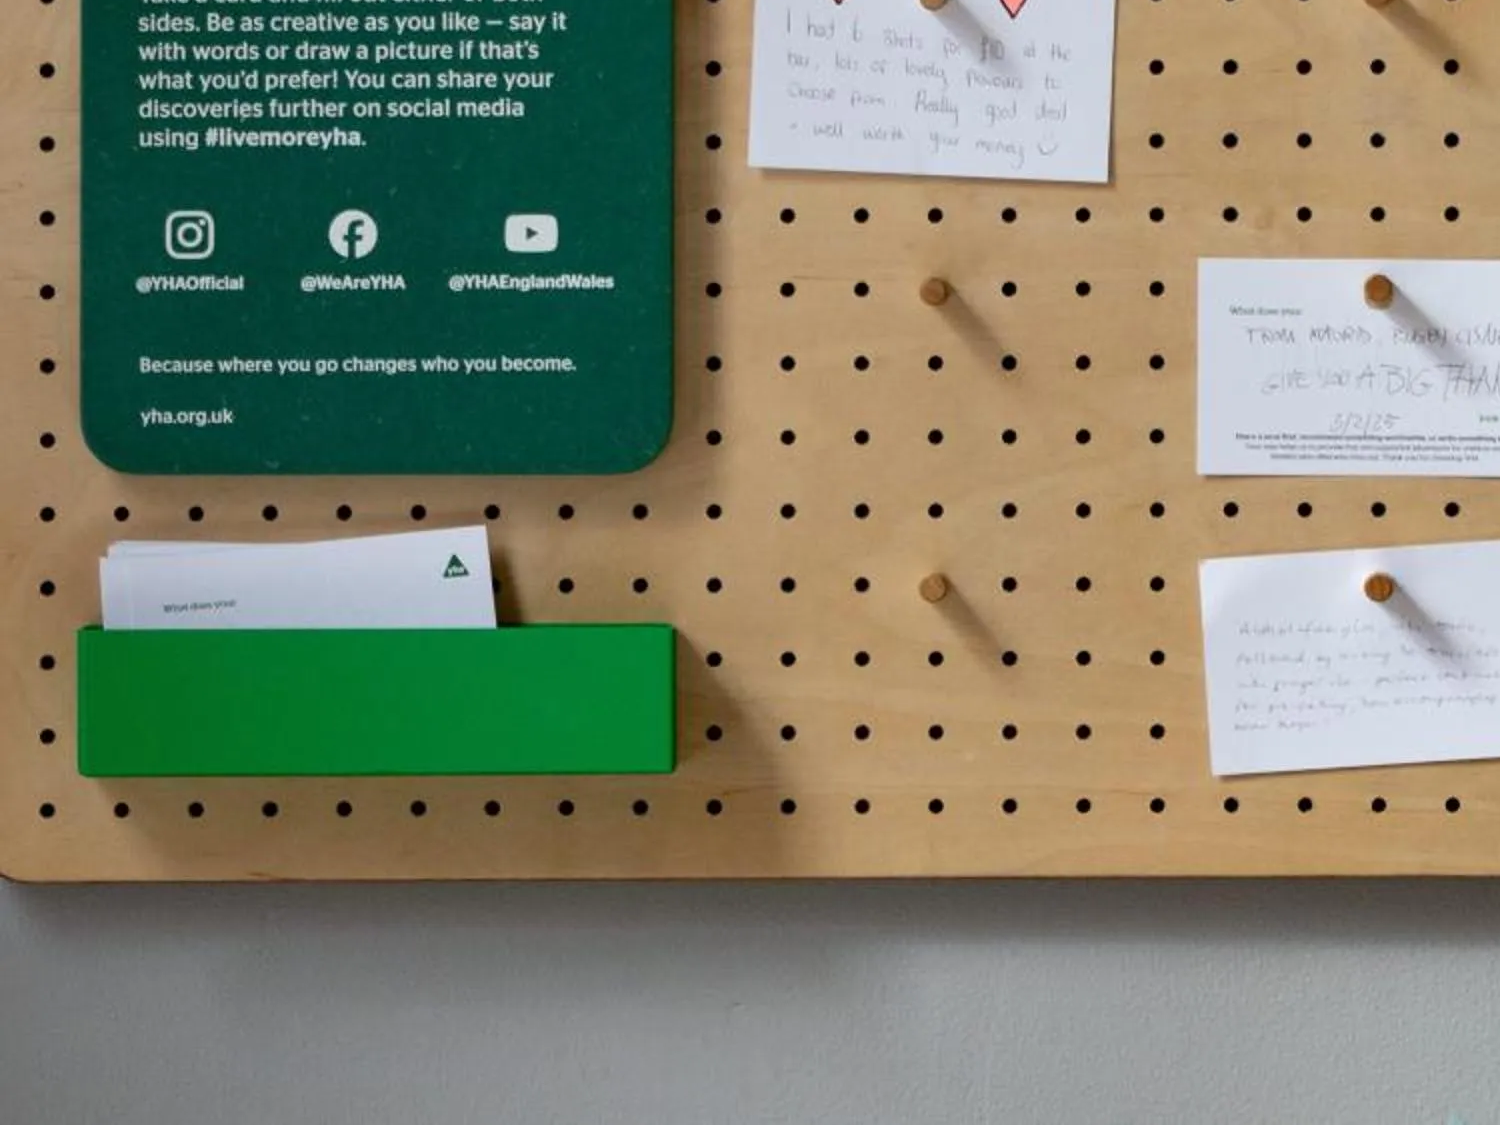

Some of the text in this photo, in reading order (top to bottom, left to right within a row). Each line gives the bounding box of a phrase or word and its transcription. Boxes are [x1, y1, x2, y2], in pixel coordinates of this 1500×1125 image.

[138, 12, 201, 33] sides.
[206, 12, 235, 32] Be
[239, 15, 265, 32] as
[269, 12, 359, 32] creative
[364, 15, 390, 32] as
[394, 15, 436, 36] you
[441, 11, 481, 32] like
[508, 15, 547, 35] say
[551, 11, 567, 31] it
[138, 39, 540, 64] with words or draw a picture if that's
[138, 68, 555, 93] what you'd prefer! You can share your
[138, 97, 525, 119] discoveries further on social media
[139, 126, 367, 151] using #livemoreyha.
[135, 275, 245, 294] @YHAOfficial
[300, 274, 406, 293] @WeAreYHA
[447, 273, 615, 293] @YHAEnglandWales
[139, 355, 577, 376] Because where you go changes who you become.
[140, 408, 233, 428] yha.org.uk
